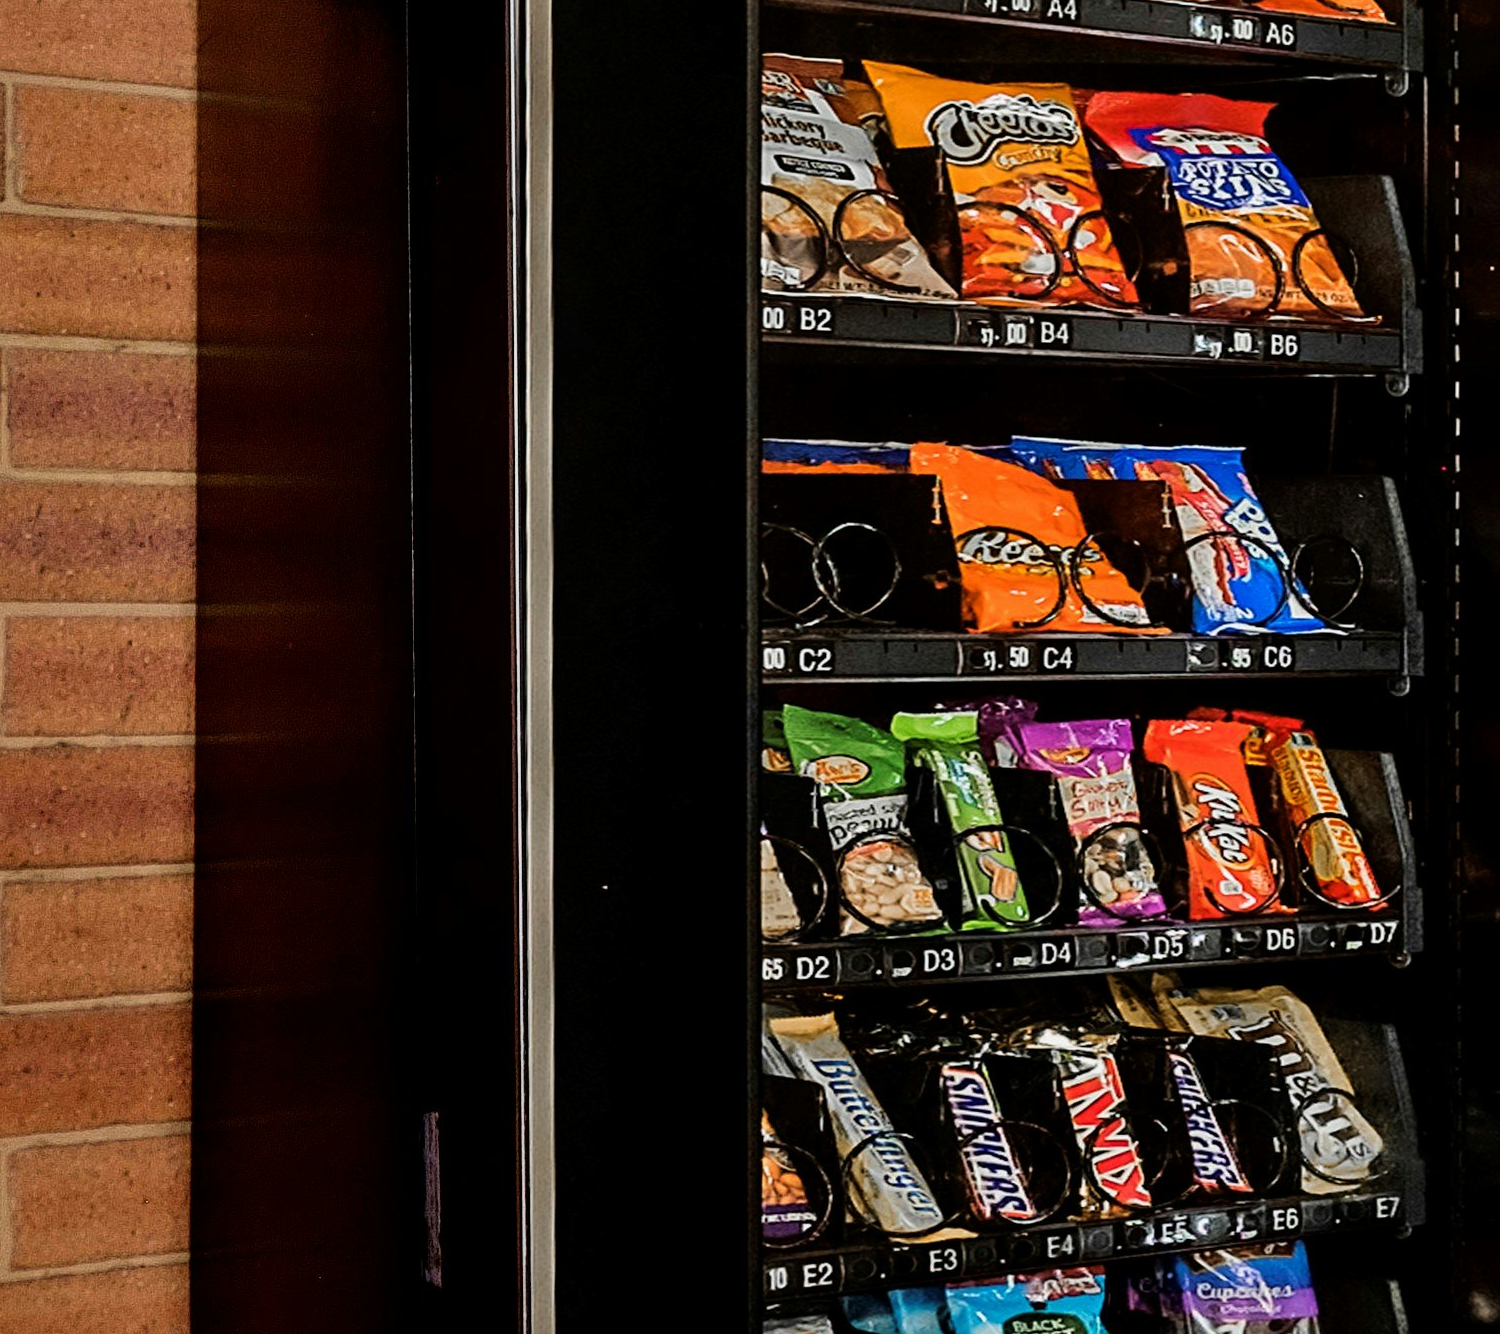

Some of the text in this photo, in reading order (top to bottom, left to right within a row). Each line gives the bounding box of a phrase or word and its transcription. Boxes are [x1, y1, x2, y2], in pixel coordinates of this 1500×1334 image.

[1266, 23, 1295, 46] A6
[928, 97, 1079, 163] Cheetos
[1179, 160, 1280, 182] POTATO
[1187, 174, 1292, 200] SKINS
[800, 308, 833, 332] B2
[1041, 322, 1070, 344] B4
[1271, 334, 1298, 356] B6
[799, 649, 833, 672] C2
[1043, 647, 1073, 670] C4
[1264, 646, 1293, 668] C6
[1266, 927, 1296, 951] D6
[1370, 921, 1400, 945] D7
[1041, 942, 1072, 965] D4
[1153, 935, 1184, 959] D5
[796, 956, 831, 980] D2
[923, 949, 956, 972] D3
[1062, 1056, 1152, 1207] TWIX
[1375, 1197, 1400, 1218] E7
[1272, 1208, 1299, 1231] E6
[1047, 1235, 1074, 1258] E4
[929, 1248, 958, 1272] E3
[802, 1262, 833, 1288] E2
[1012, 1317, 1067, 1334] BLACK
